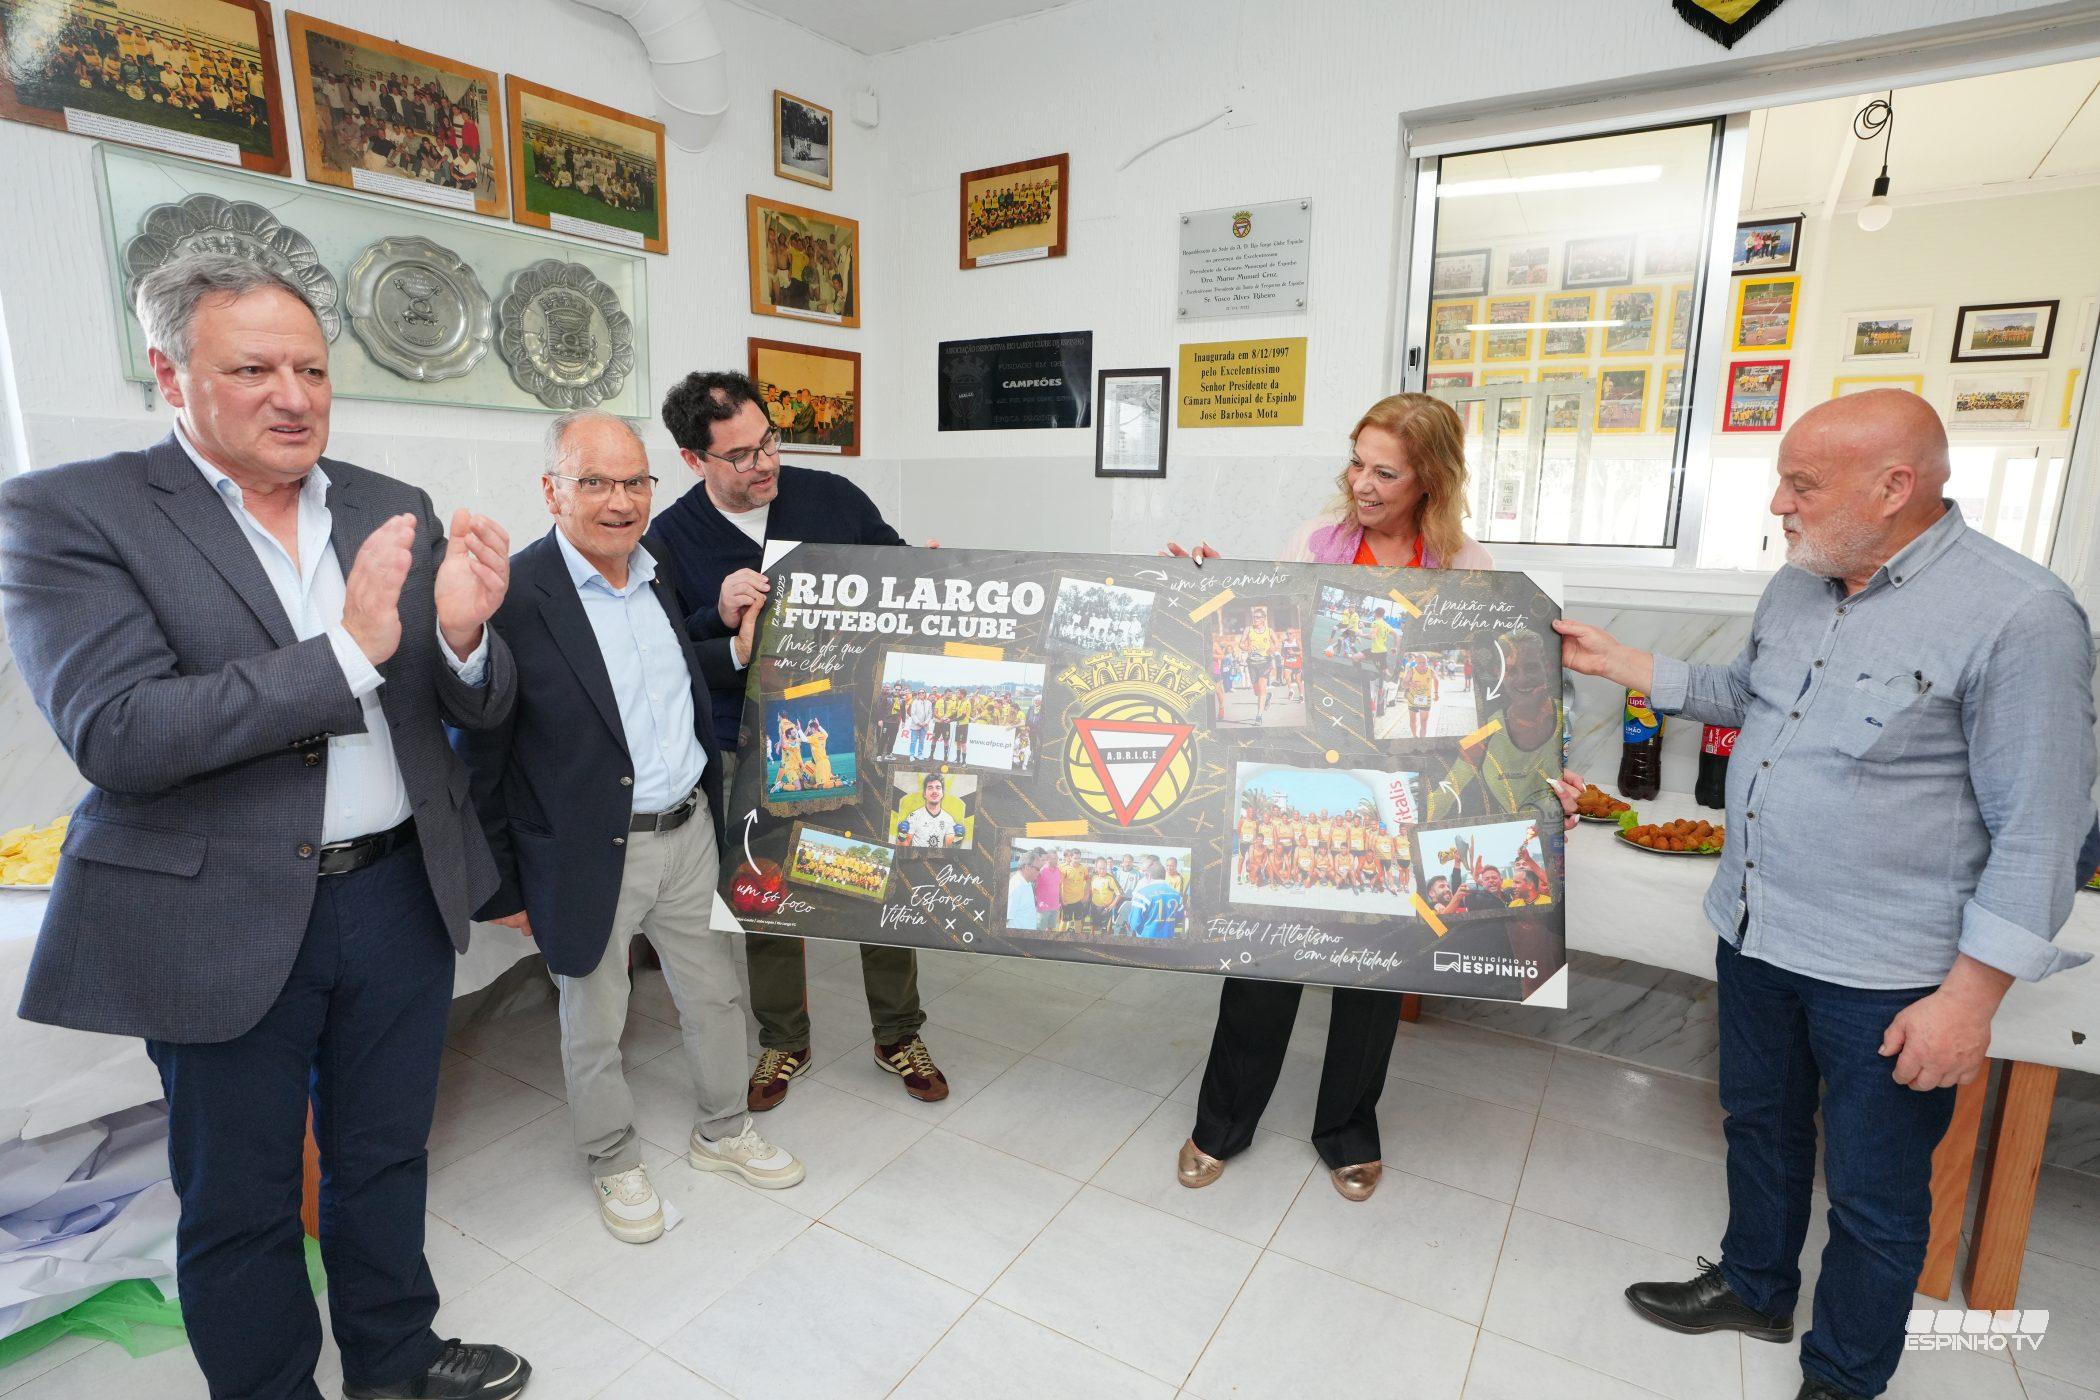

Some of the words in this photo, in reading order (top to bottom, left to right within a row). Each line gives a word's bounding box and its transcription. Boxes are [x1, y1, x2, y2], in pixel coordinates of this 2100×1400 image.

[1253, 292, 1276, 300] Ribeiro
[1194, 351, 1235, 363] Inaugurada
[1238, 352, 1248, 360] em
[1252, 347, 1289, 359] 8/12/1997
[1201, 367, 1217, 379] pelo
[1220, 364, 1280, 376] Excelentíssimo
[1002, 377, 1062, 389] CAMPEÕES
[1200, 381, 1225, 392] Senhor
[1229, 380, 1267, 391] Presidente
[1271, 380, 1279, 389] da
[1183, 395, 1211, 405] Câmara
[1215, 394, 1252, 405] Municipal
[1255, 394, 1264, 403] de
[1266, 392, 1297, 404] Espinho
[1200, 410, 1217, 420] José
[1220, 409, 1252, 420] Barbosa
[1257, 409, 1278, 418] Mota
[777, 574, 786, 598] 2025
[1170, 577, 1195, 591] um
[1222, 566, 1290, 589] caminho
[787, 572, 869, 607] RIO
[878, 577, 1045, 615] LARGO
[1422, 595, 1439, 614] A
[1440, 600, 1486, 614] paixão
[1489, 601, 1515, 612] não
[783, 608, 913, 634] FUTEBOL
[921, 614, 1017, 639] CLUBE
[1451, 612, 1490, 631] linha
[1493, 614, 1529, 635] meta
[776, 634, 815, 654] Mais
[819, 637, 837, 658] do
[841, 641, 866, 660] que
[774, 657, 798, 669] um
[800, 653, 844, 673] clube
[936, 864, 983, 886] Garra
[737, 884, 760, 896] um
[777, 893, 816, 914] foco
[910, 885, 973, 912] Esforço
[880, 904, 927, 930] Vitória
[1154, 899, 1178, 922] 12
[1206, 918, 1259, 942] Futebol
[1270, 923, 1343, 946] Atletismo
[1294, 949, 1327, 961] com
[1329, 948, 1402, 971] identidade
[1462, 962, 1538, 979] ESPINHO
[1463, 955, 1519, 965] MUNICÍPIO
